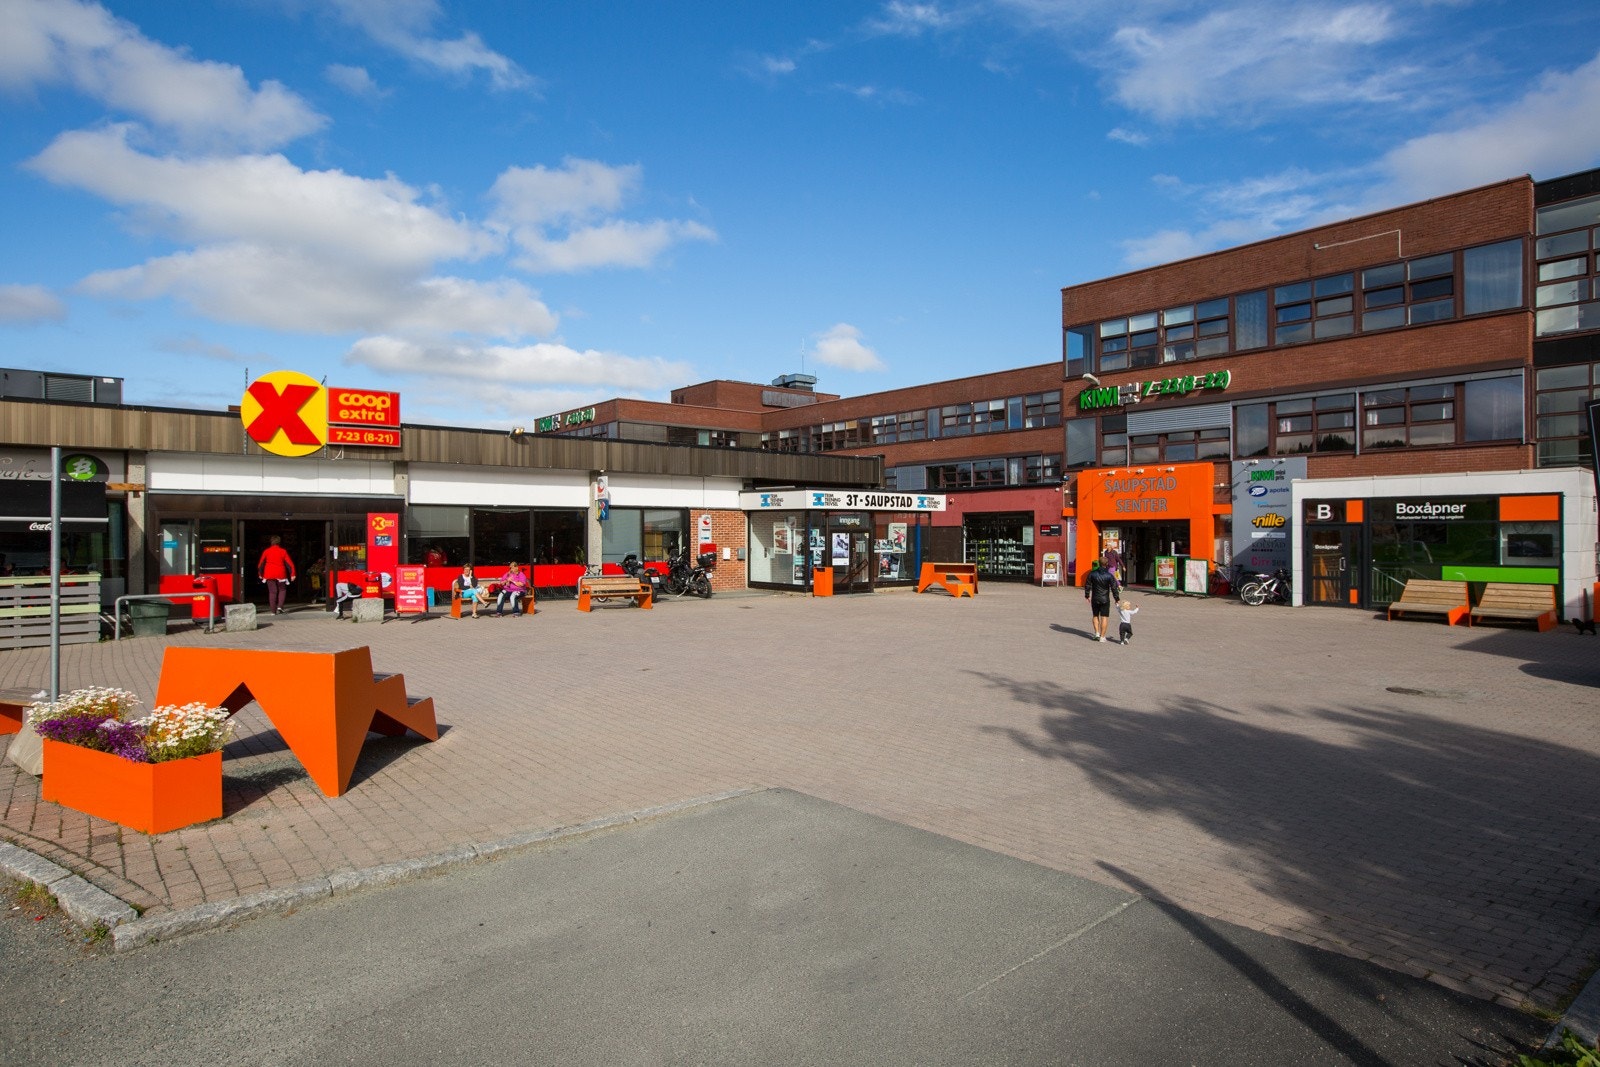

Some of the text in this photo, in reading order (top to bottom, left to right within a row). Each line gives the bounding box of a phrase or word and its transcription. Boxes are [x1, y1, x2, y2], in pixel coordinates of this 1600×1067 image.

[338, 393, 391, 410] coop
[1080, 386, 1119, 409] KIWI
[339, 408, 385, 421] extra
[336, 431, 394, 444] 7-23 (8-21)
[1251, 470, 1275, 481] KIWI
[1104, 476, 1177, 493] SAUPSTAD
[1115, 498, 1168, 513] SENTER
[1317, 504, 1331, 519] B
[1396, 502, 1467, 516] Boxåpner
